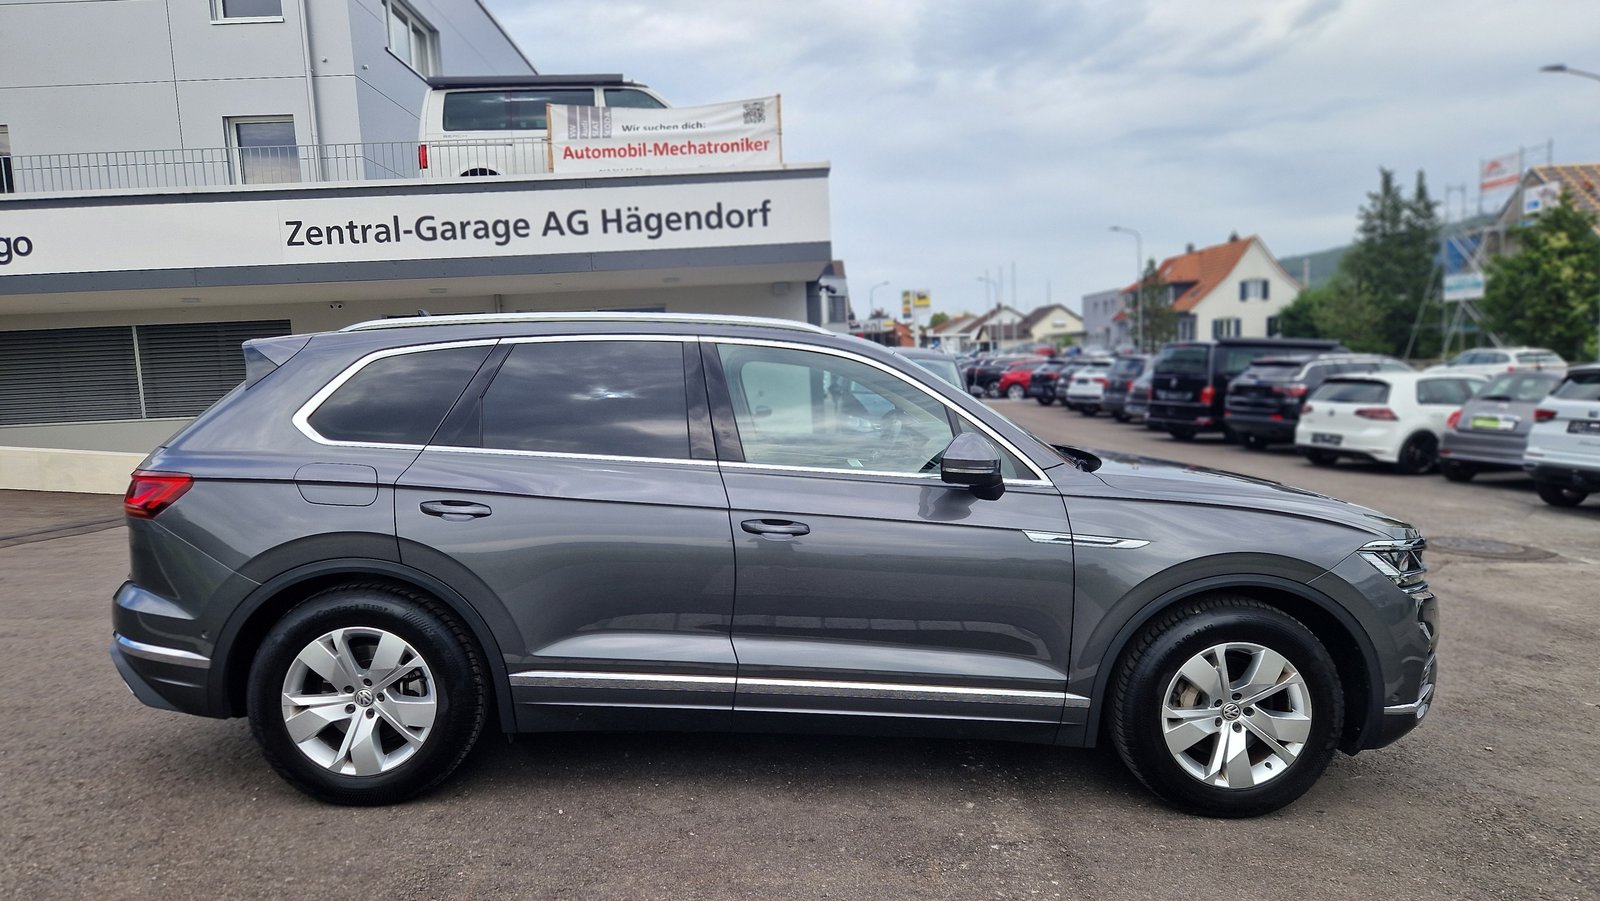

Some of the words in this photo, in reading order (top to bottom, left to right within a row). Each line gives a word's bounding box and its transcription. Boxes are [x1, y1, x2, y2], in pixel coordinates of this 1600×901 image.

[621, 124, 640, 132] Wir
[643, 123, 679, 131] suchen
[681, 121, 706, 130] dich:
[562, 138, 770, 160] Automobil-Mechatroniker
[285, 215, 530, 246] Zentral-Garage
[541, 209, 589, 237] AG
[601, 199, 771, 239] Hägendorf
